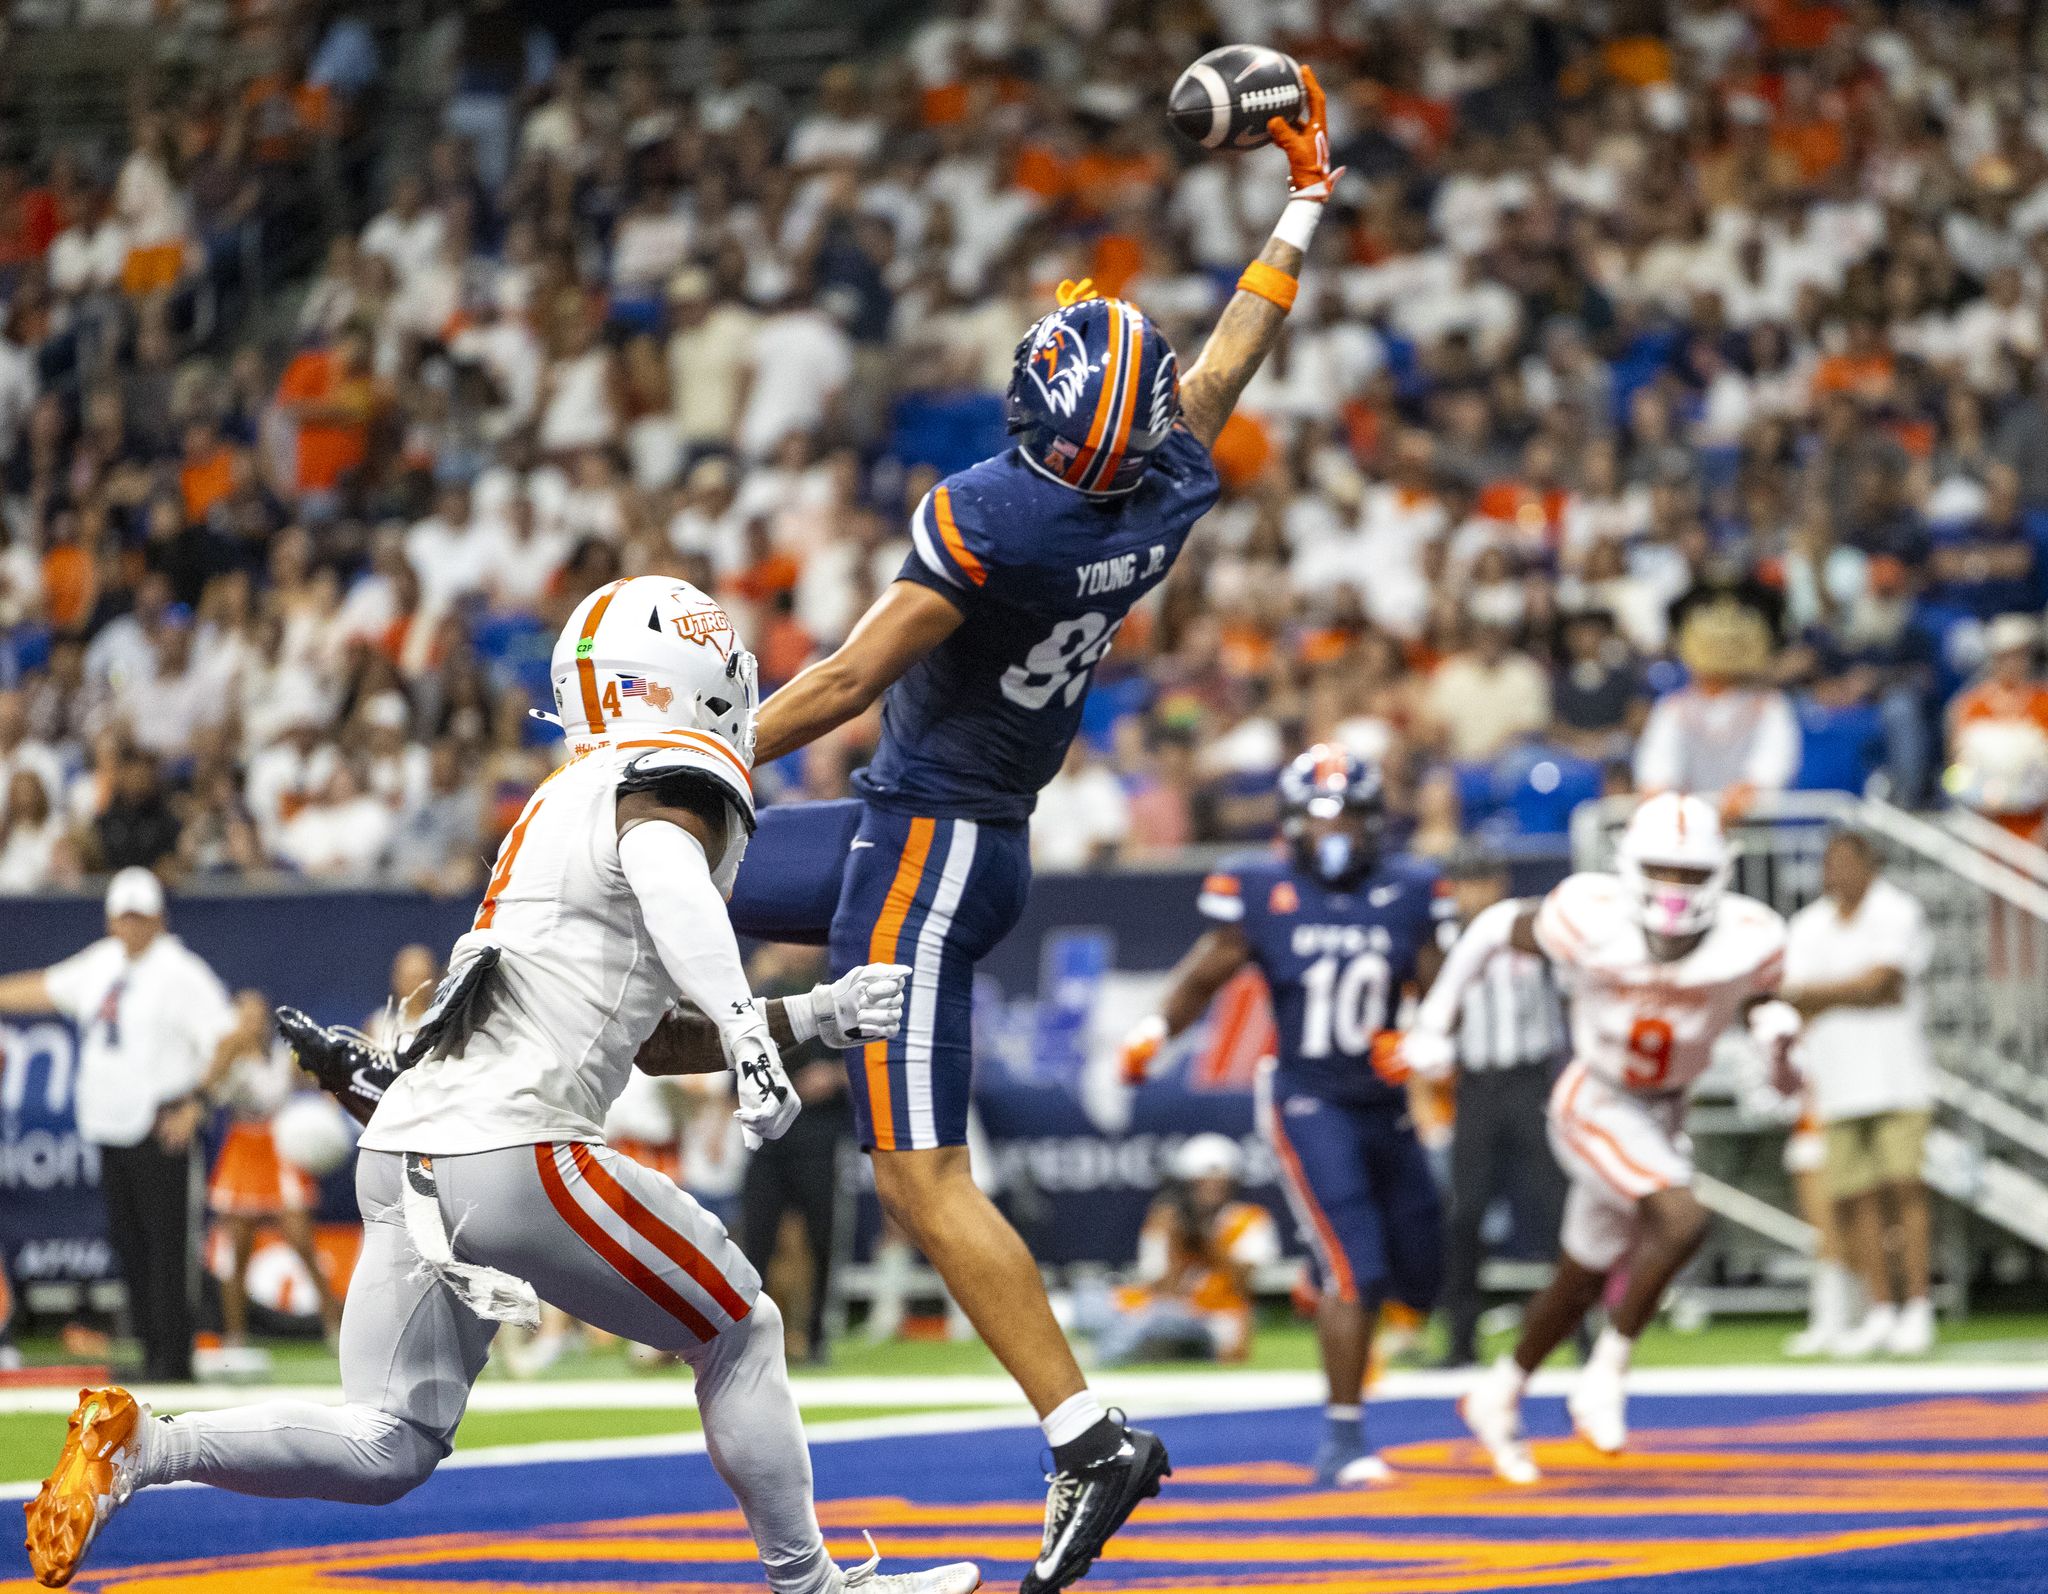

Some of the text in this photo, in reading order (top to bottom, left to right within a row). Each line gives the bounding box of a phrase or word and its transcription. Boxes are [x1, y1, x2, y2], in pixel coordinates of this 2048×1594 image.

[1075, 553, 1137, 598] YOUNG
[670, 610, 734, 640] UTRG
[577, 644, 593, 653] C2P
[602, 681, 622, 717] 4
[1300, 953, 1391, 1058] 10
[1624, 1017, 1673, 1089] 9
